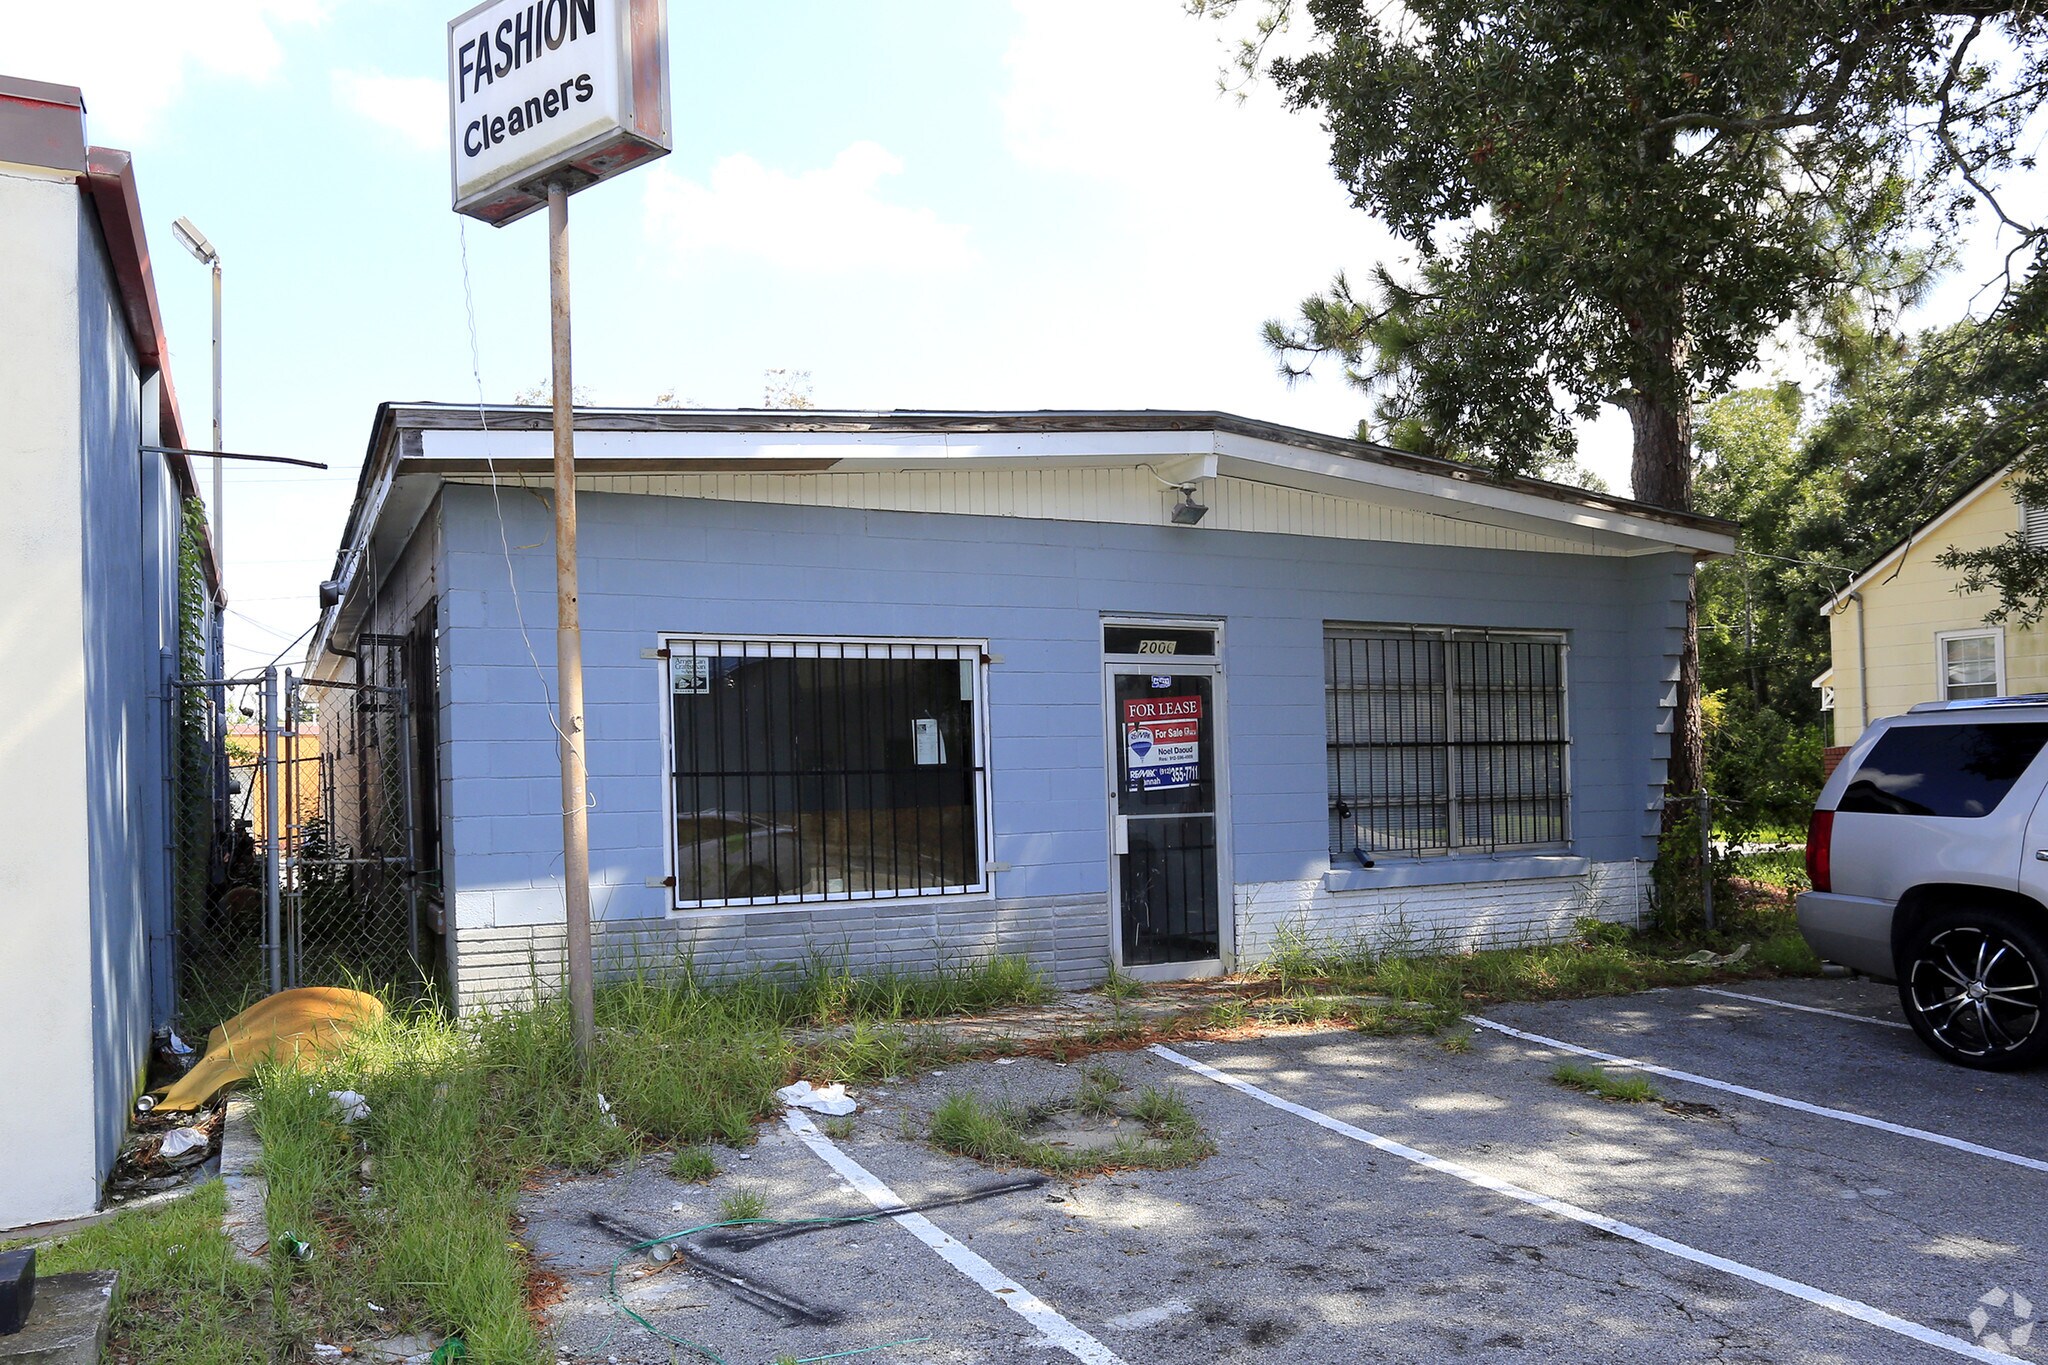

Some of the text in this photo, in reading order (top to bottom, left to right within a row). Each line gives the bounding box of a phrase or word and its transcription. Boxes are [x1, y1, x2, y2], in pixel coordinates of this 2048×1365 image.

[459, 0, 597, 104] FASHION
[463, 73, 594, 158] Cleaners
[1139, 641, 1175, 655] 2000
[1129, 700, 1198, 718] FOR LEASE
[1155, 729, 1167, 739] For
[1168, 727, 1183, 738] Sale
[1158, 747, 1173, 755] Noel
[1171, 765, 1198, 783] 355-7711
